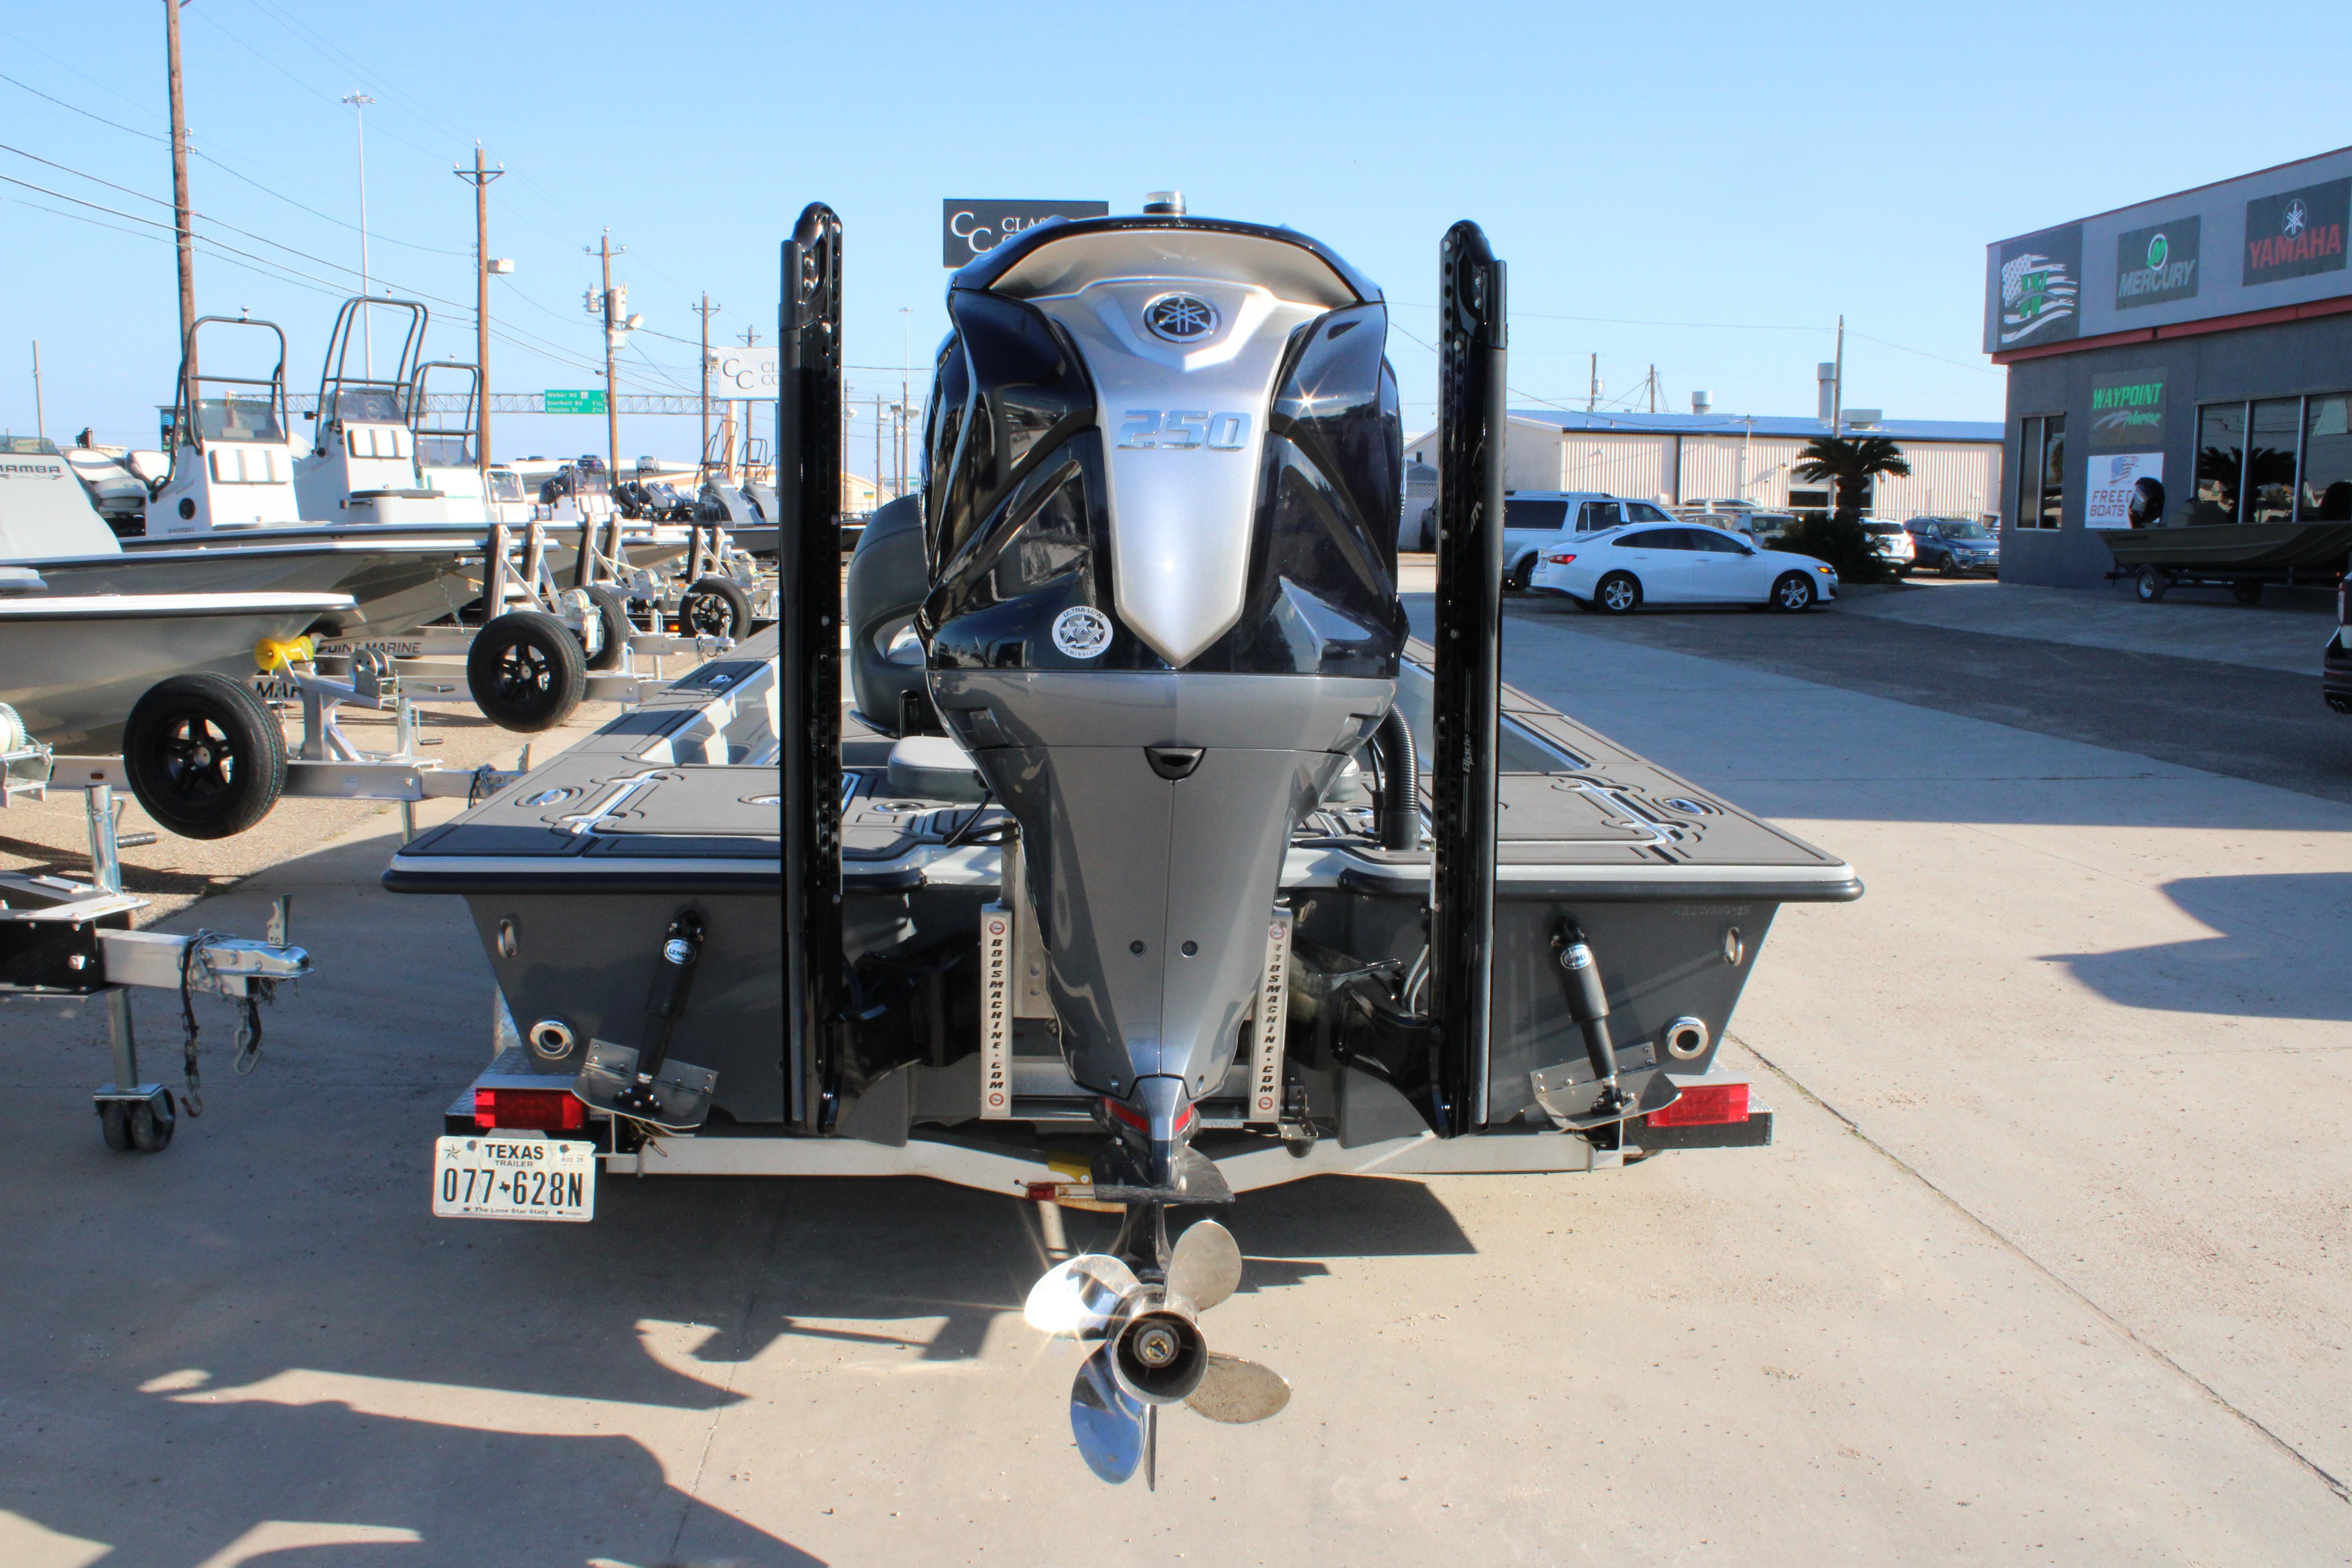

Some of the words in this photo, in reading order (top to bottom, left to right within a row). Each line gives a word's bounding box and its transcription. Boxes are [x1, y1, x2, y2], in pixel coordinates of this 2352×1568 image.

[2250, 224, 2341, 269] YAMAHA
[2118, 259, 2196, 298] MERCURY
[2092, 383, 2163, 409] WAYPOINT
[1117, 410, 1254, 452] 250
[2089, 505, 2125, 516] BOATS
[1065, 648, 1099, 657] EMISSION
[1463, 733, 1475, 773] Blade
[485, 1143, 544, 1160] TEXAS
[443, 1168, 495, 1202] 077
[513, 1170, 583, 1207] 628N
